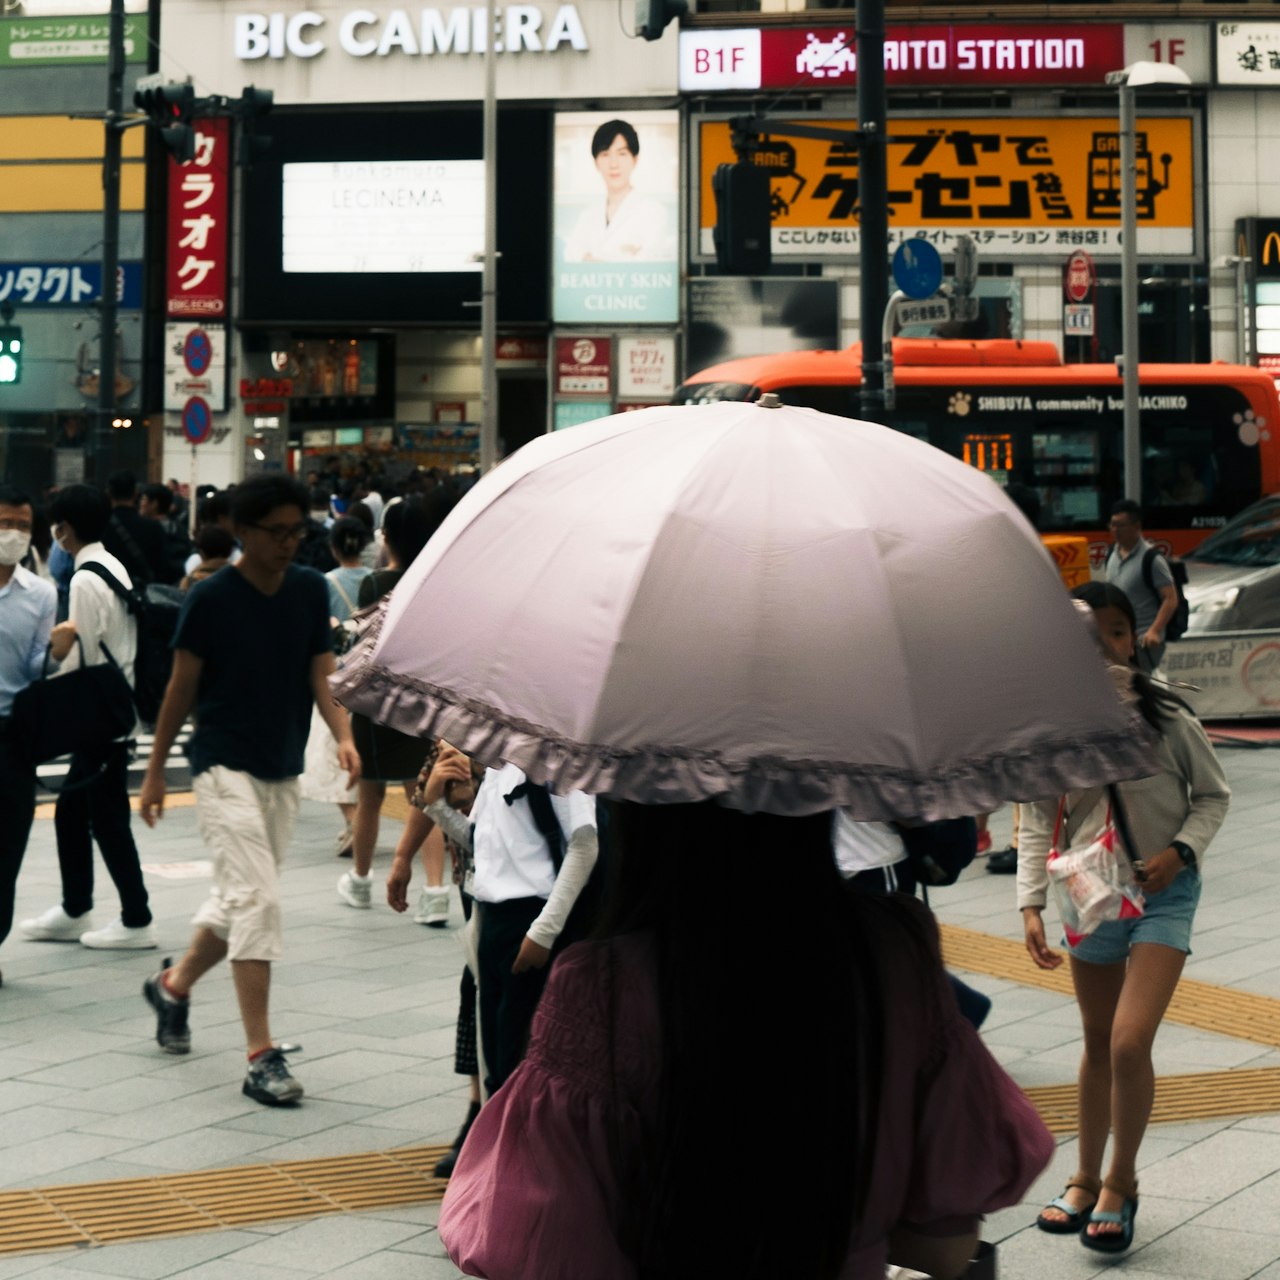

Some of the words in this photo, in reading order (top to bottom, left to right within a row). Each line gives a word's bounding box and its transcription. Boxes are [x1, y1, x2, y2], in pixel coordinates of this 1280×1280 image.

[234, 12, 325, 62] BIC
[338, 4, 589, 58] CAMERA
[1220, 24, 1239, 37] 6F
[694, 47, 746, 74] B1F
[883, 39, 947, 71] AITO
[957, 38, 1086, 71] STATION
[1148, 38, 1186, 66] 1F
[176, 130, 217, 291] カラオケ
[560, 272, 627, 289] BEAUTY
[629, 271, 673, 288] SKIN
[584, 294, 648, 311] CLINIC
[978, 395, 1033, 411] SHIBUYA
[1035, 395, 1104, 414] community
[1108, 395, 1125, 411] bu
[1137, 396, 1188, 411] ACHIKO
